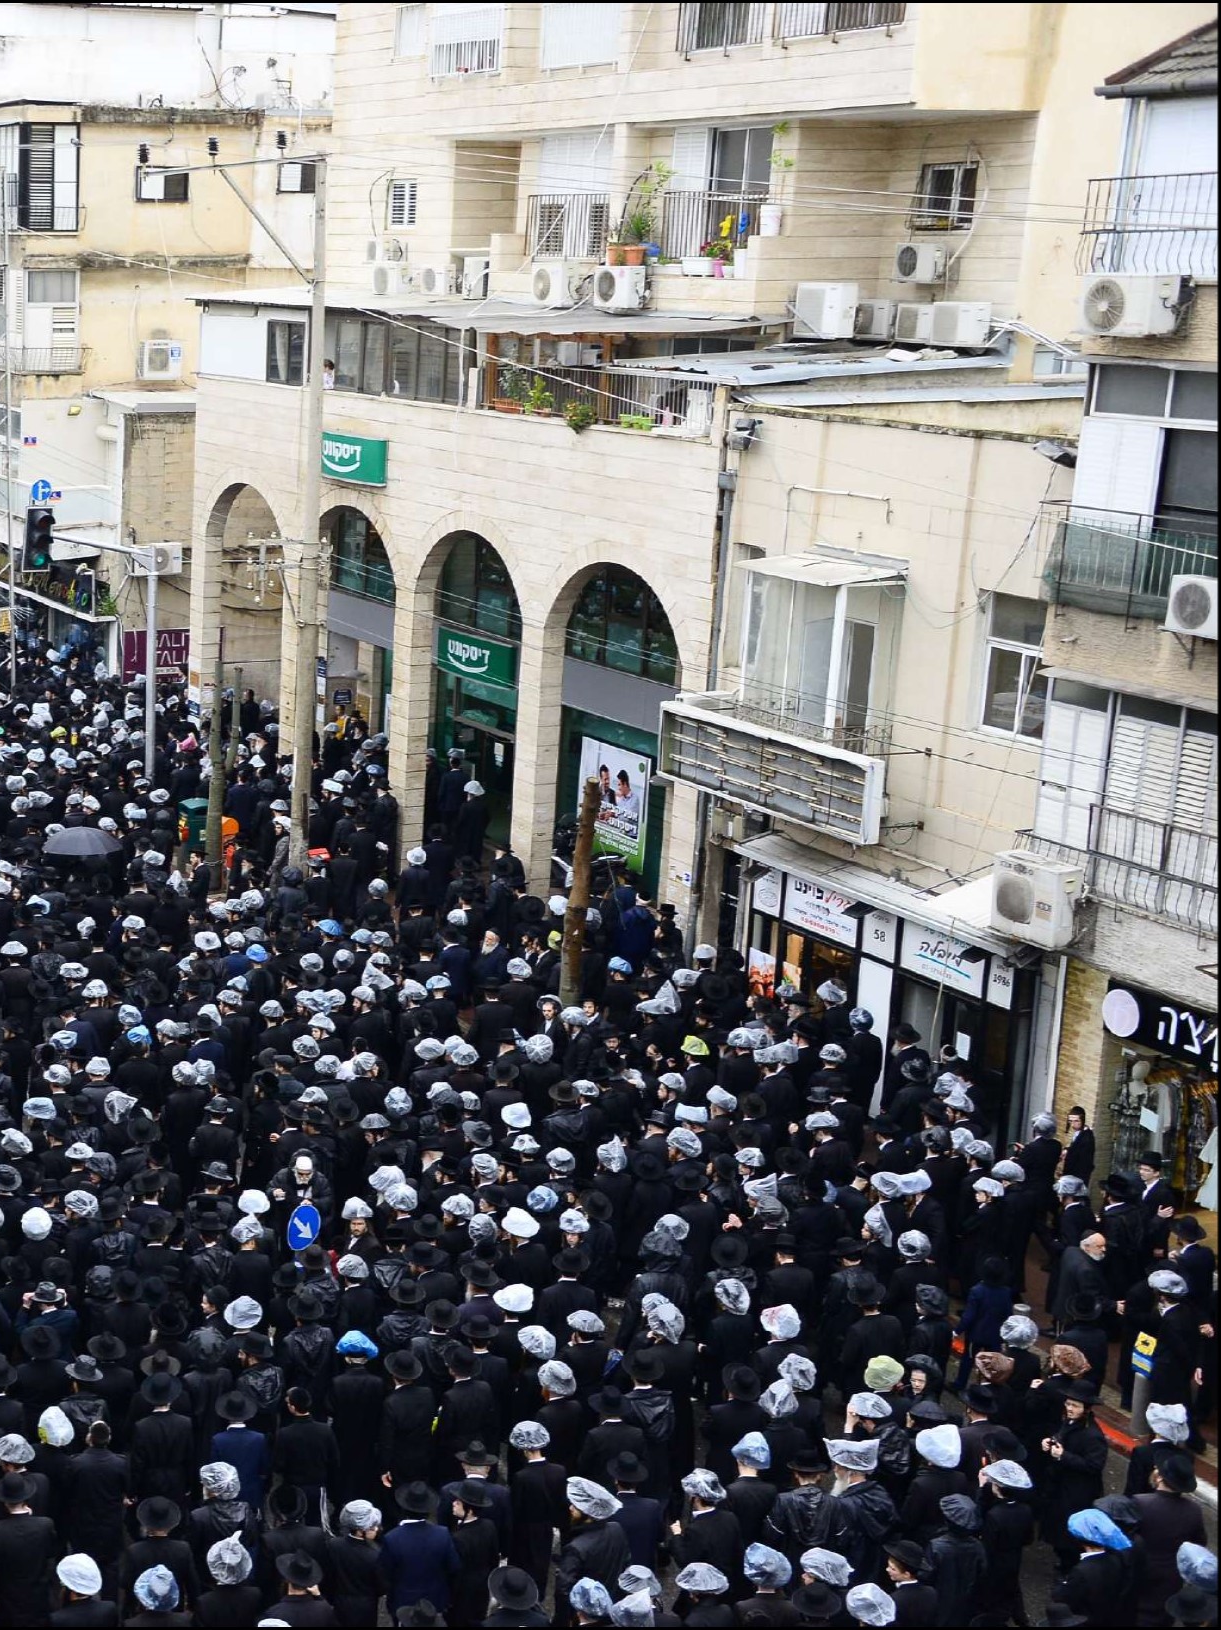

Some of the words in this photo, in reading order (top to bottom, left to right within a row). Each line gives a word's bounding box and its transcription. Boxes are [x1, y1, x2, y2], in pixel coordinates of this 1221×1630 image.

[322, 439, 362, 462] דיסקונט
[156, 632, 191, 648] ALI
[447, 639, 490, 664] דיסקונט
[873, 929, 886, 943] 58
[992, 973, 1011, 988] 1986
